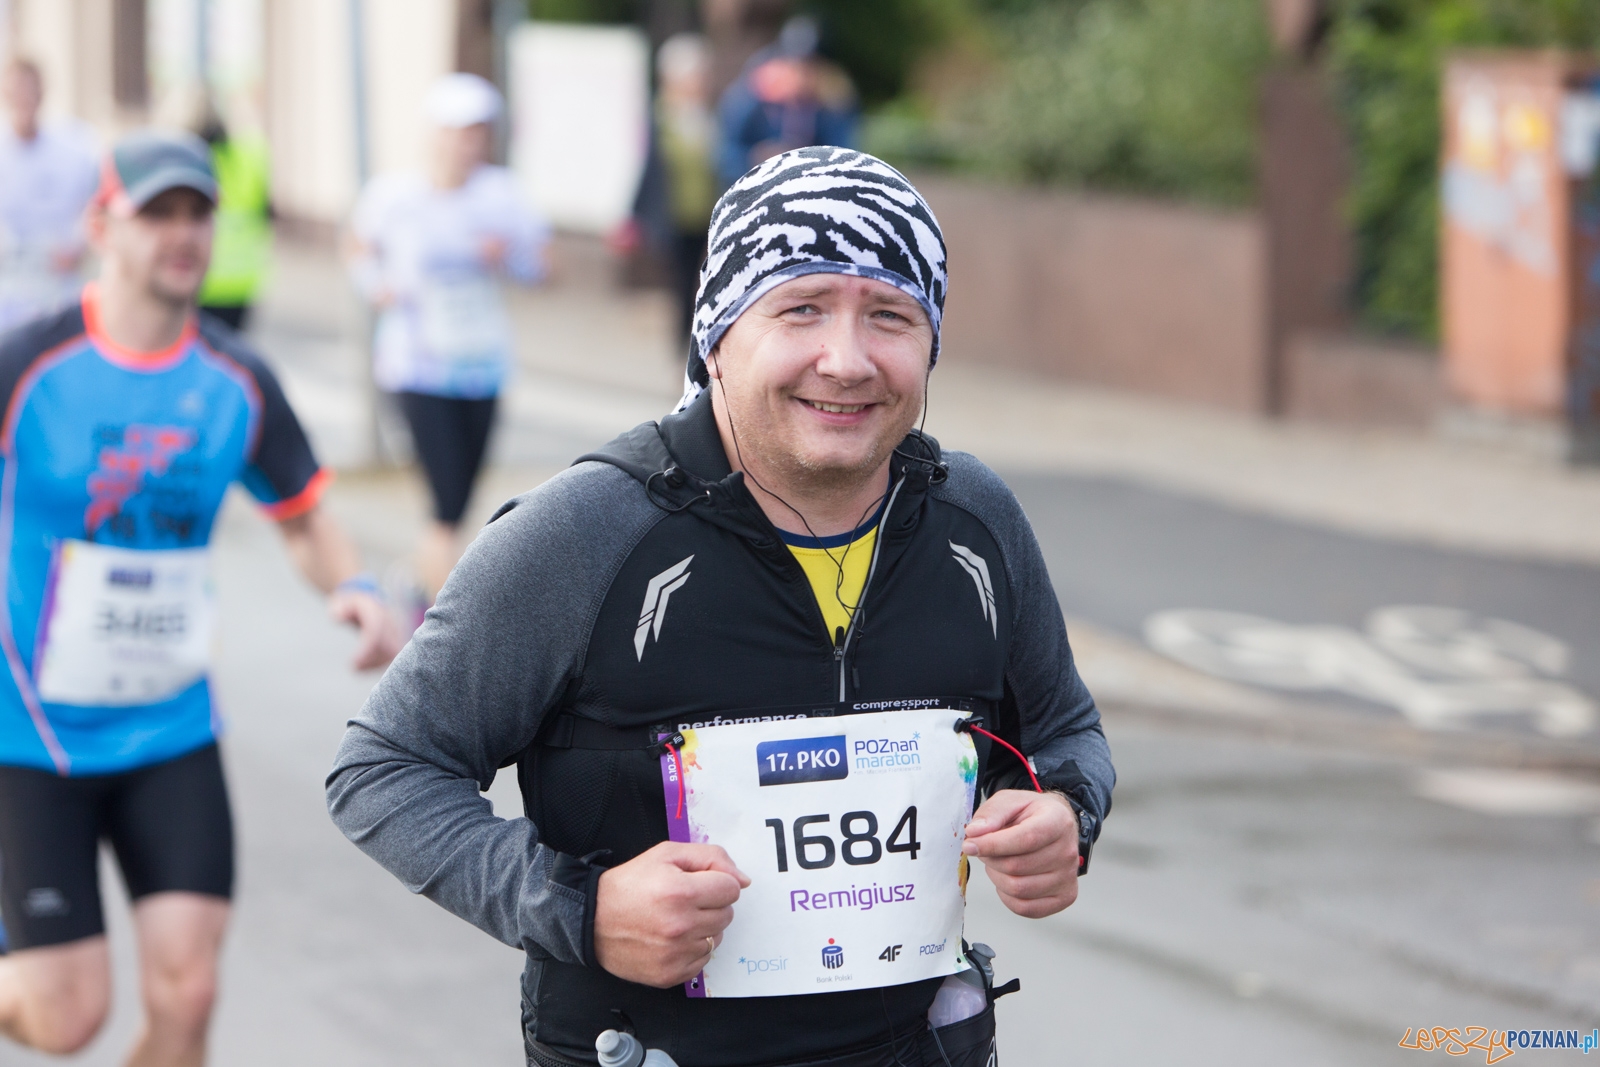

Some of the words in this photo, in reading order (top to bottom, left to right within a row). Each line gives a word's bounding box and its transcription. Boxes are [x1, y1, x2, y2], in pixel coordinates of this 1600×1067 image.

[853, 698, 940, 711] compressport
[765, 752, 794, 772] 17.
[796, 748, 841, 770] PKO
[855, 751, 921, 769] maraton
[765, 805, 921, 873] 1684
[789, 882, 916, 912] Remigiusz
[878, 944, 903, 962] 4F
[816, 976, 833, 984] Bank
[834, 974, 853, 982] Polski
